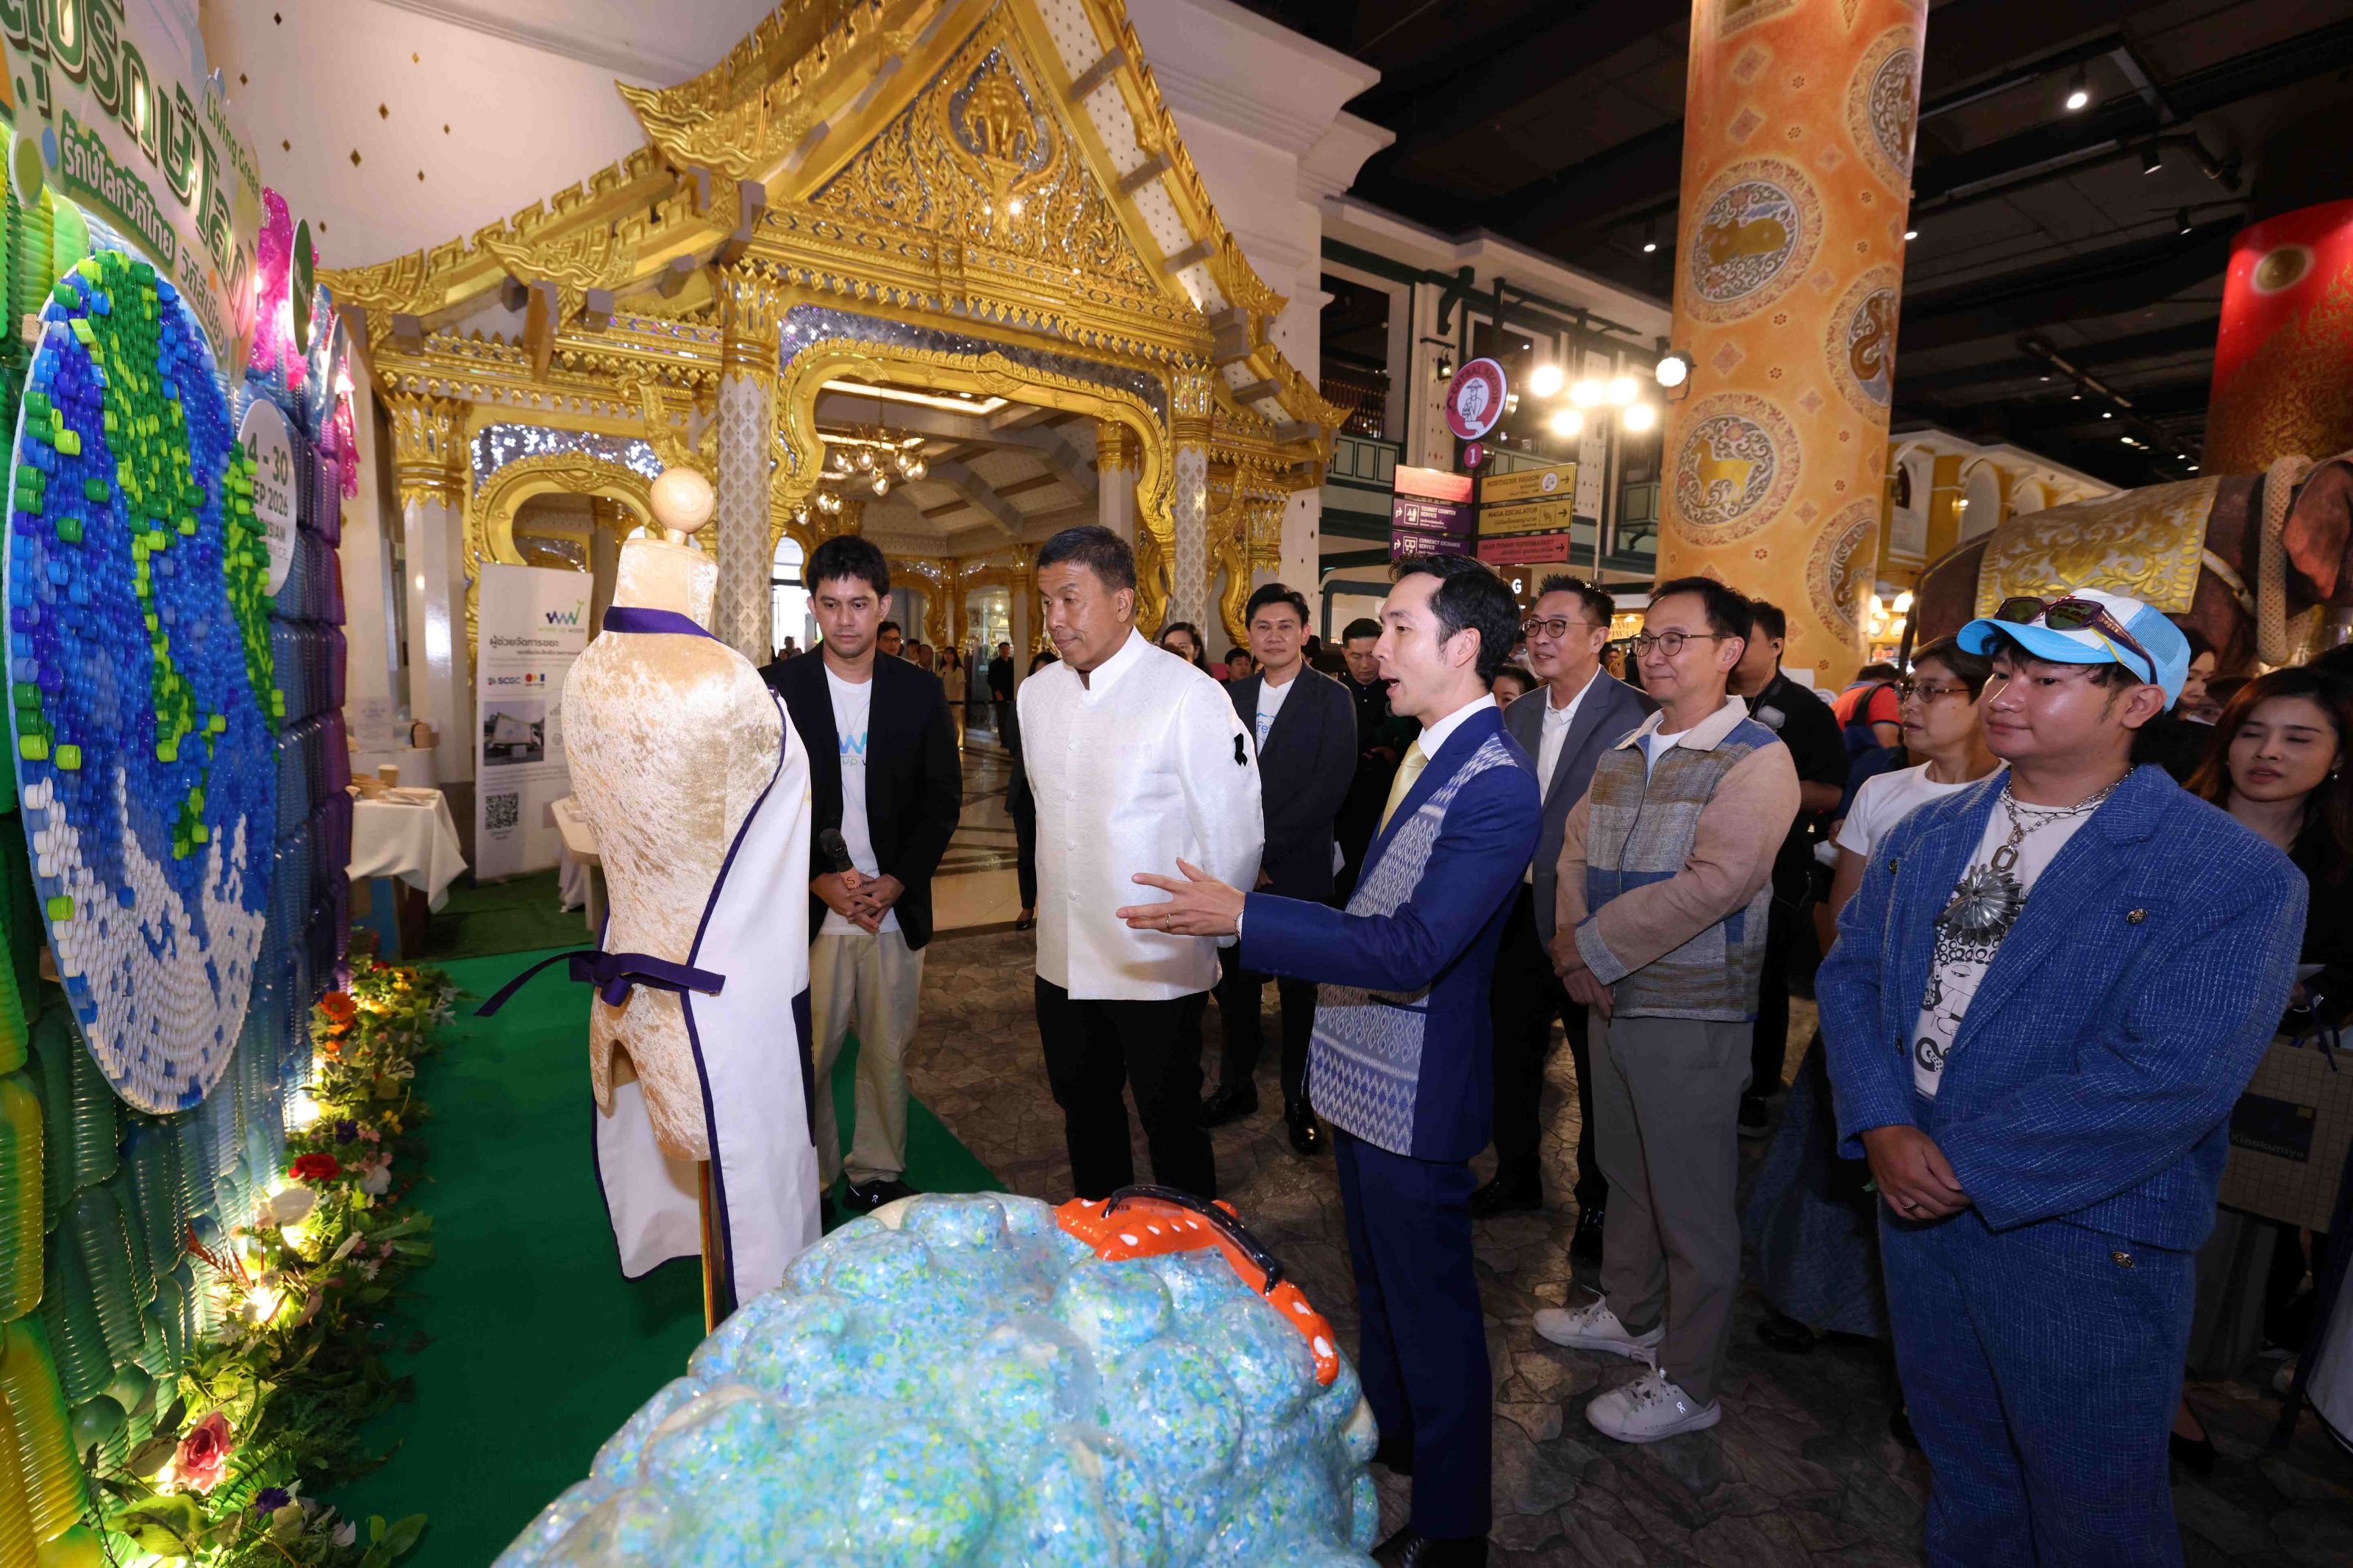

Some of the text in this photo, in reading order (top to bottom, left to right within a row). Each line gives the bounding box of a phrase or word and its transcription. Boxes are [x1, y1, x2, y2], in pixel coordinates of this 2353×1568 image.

[207, 96, 260, 203] Living Green
[1483, 367, 1499, 405] REGION
[1469, 448, 1477, 465] 1
[273, 445, 288, 487] 30
[1487, 477, 1517, 487] NORTHERN
[1518, 474, 1540, 484] REGION
[1438, 508, 1456, 516] COUNTER
[1488, 506, 1538, 518] NAGA ESCALATOR
[498, 676, 521, 684] SCGC
